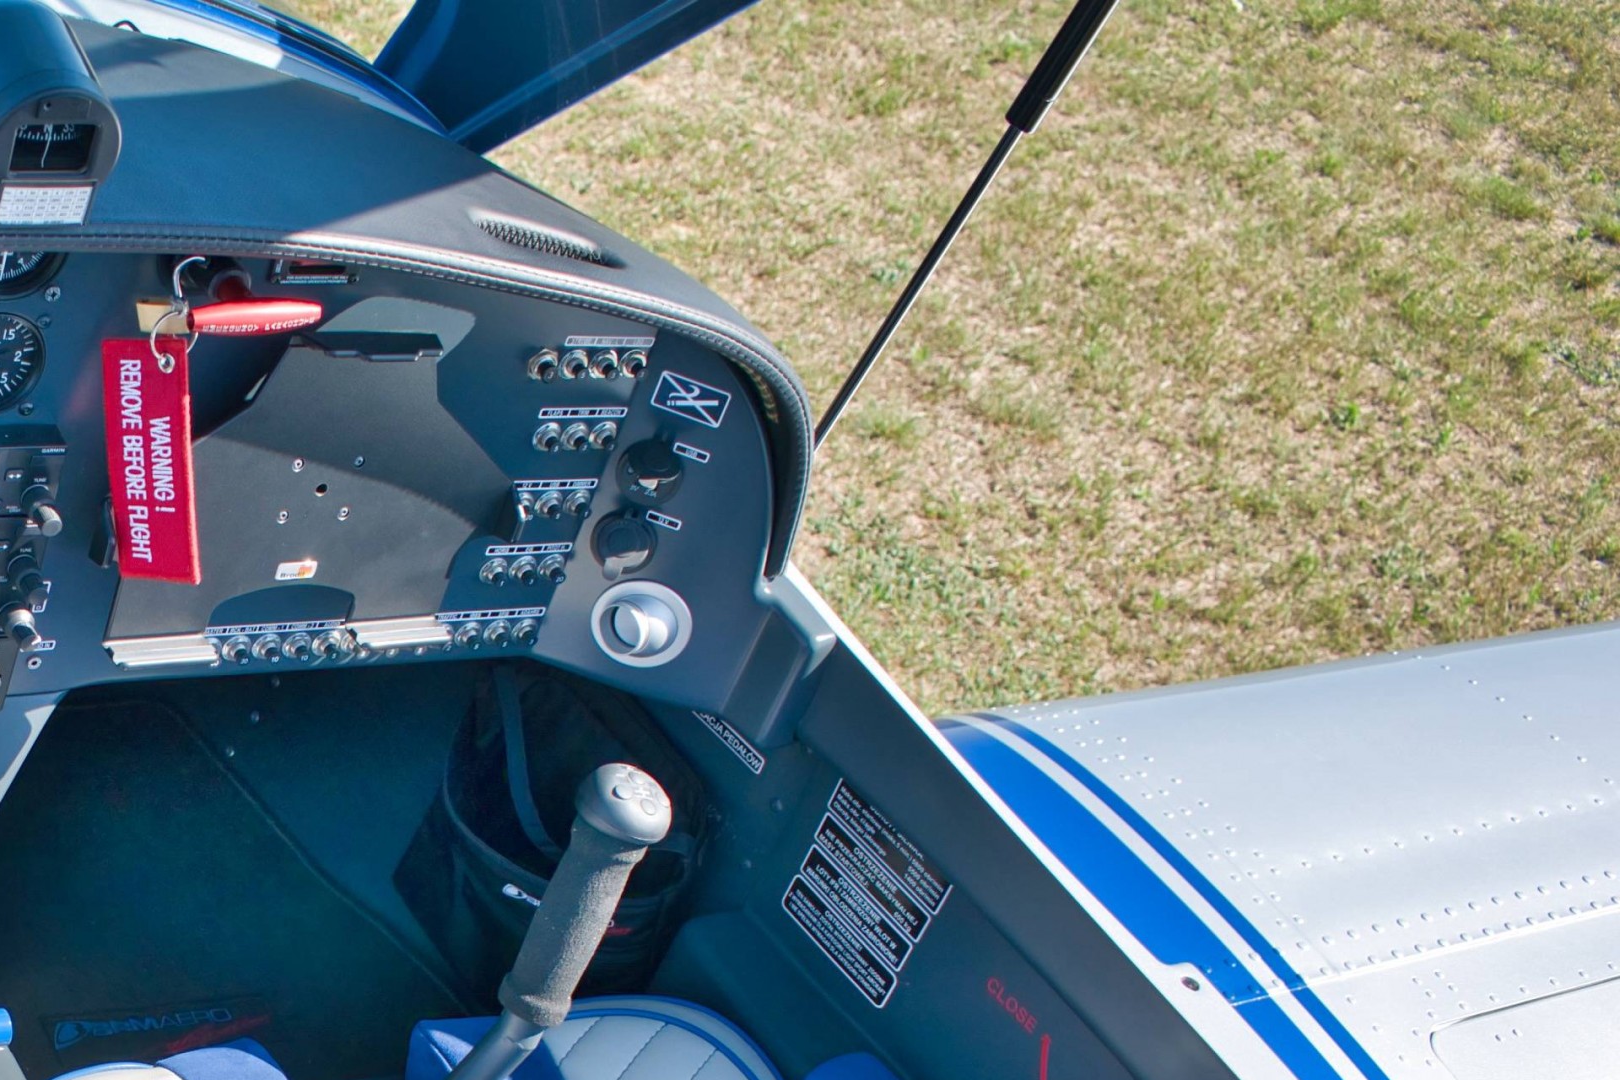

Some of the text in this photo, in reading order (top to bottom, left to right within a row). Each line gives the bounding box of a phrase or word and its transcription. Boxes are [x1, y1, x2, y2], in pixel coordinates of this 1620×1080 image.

[14, 351, 22, 362] 2
[120, 359, 152, 563] REMOVE BEFORE FLIGHT
[149, 416, 175, 502] WARNING
[723, 725, 762, 770] PEDAŁÓW
[817, 832, 836, 853] MASY
[851, 845, 898, 895] OSTRZEŻENIE
[814, 862, 831, 882] LOTY
[839, 888, 876, 929] ZAMIERZONY
[872, 923, 891, 944] WLOT
[833, 837, 877, 884] PRZEKRACZAĆ
[873, 878, 919, 928] MAKSYMALNEJ
[836, 874, 882, 925] OSTRZEŻENIE
[804, 864, 899, 966] WARUNKI OBLODZENIA ZABRONIONE!
[986, 977, 1039, 1033] CLOSE
